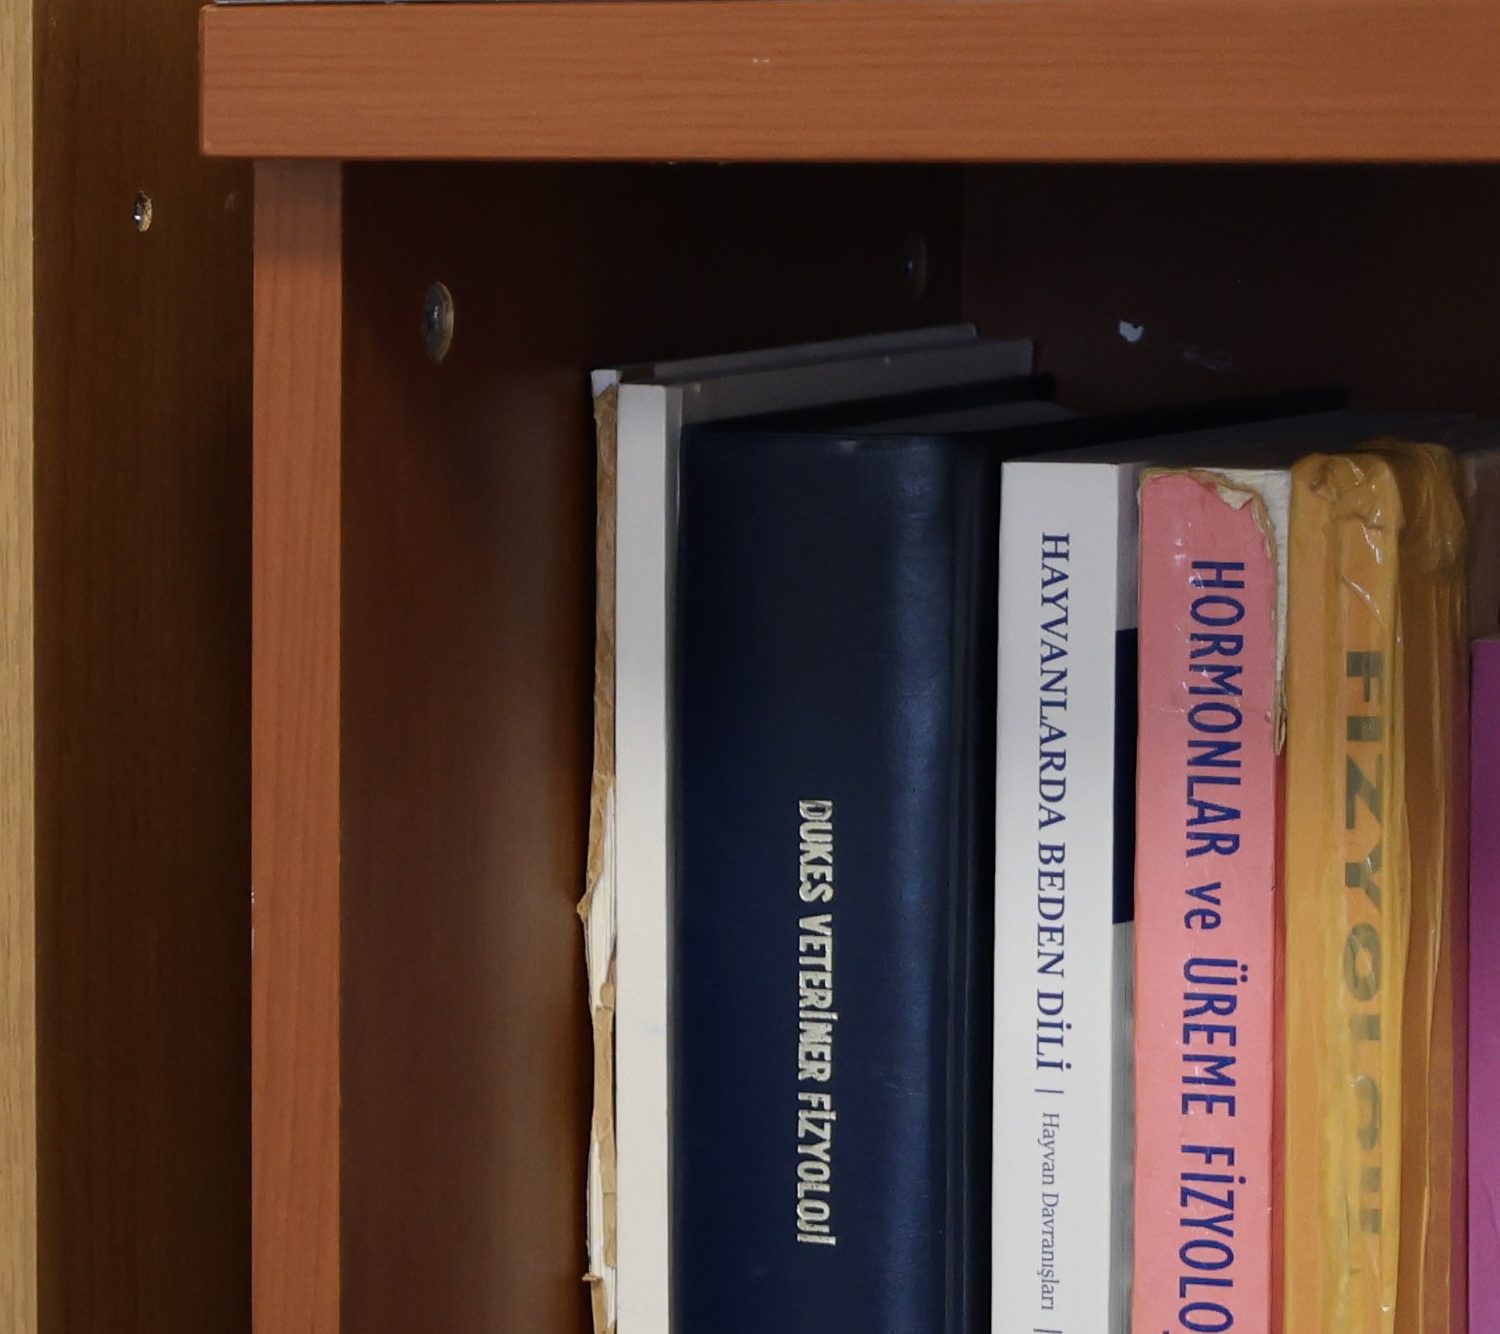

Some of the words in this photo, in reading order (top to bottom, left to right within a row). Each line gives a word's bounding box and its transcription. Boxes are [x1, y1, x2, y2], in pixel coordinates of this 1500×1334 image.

[1037, 531, 1071, 832] HAYVANLARDA
[1185, 560, 1247, 859] HORMONLAR
[797, 798, 835, 904] DUKES
[1037, 839, 1067, 979] BEDEN
[1183, 880, 1223, 931] ve
[797, 912, 840, 1083] VETERİNER
[1035, 987, 1073, 1073] DİLİ
[1180, 956, 1250, 1119] ÜREME
[795, 1090, 837, 1247] FİZYOLOJİ
[1036, 1111, 1061, 1187] Hayvan
[1036, 1191, 1061, 1312] Davranışları
